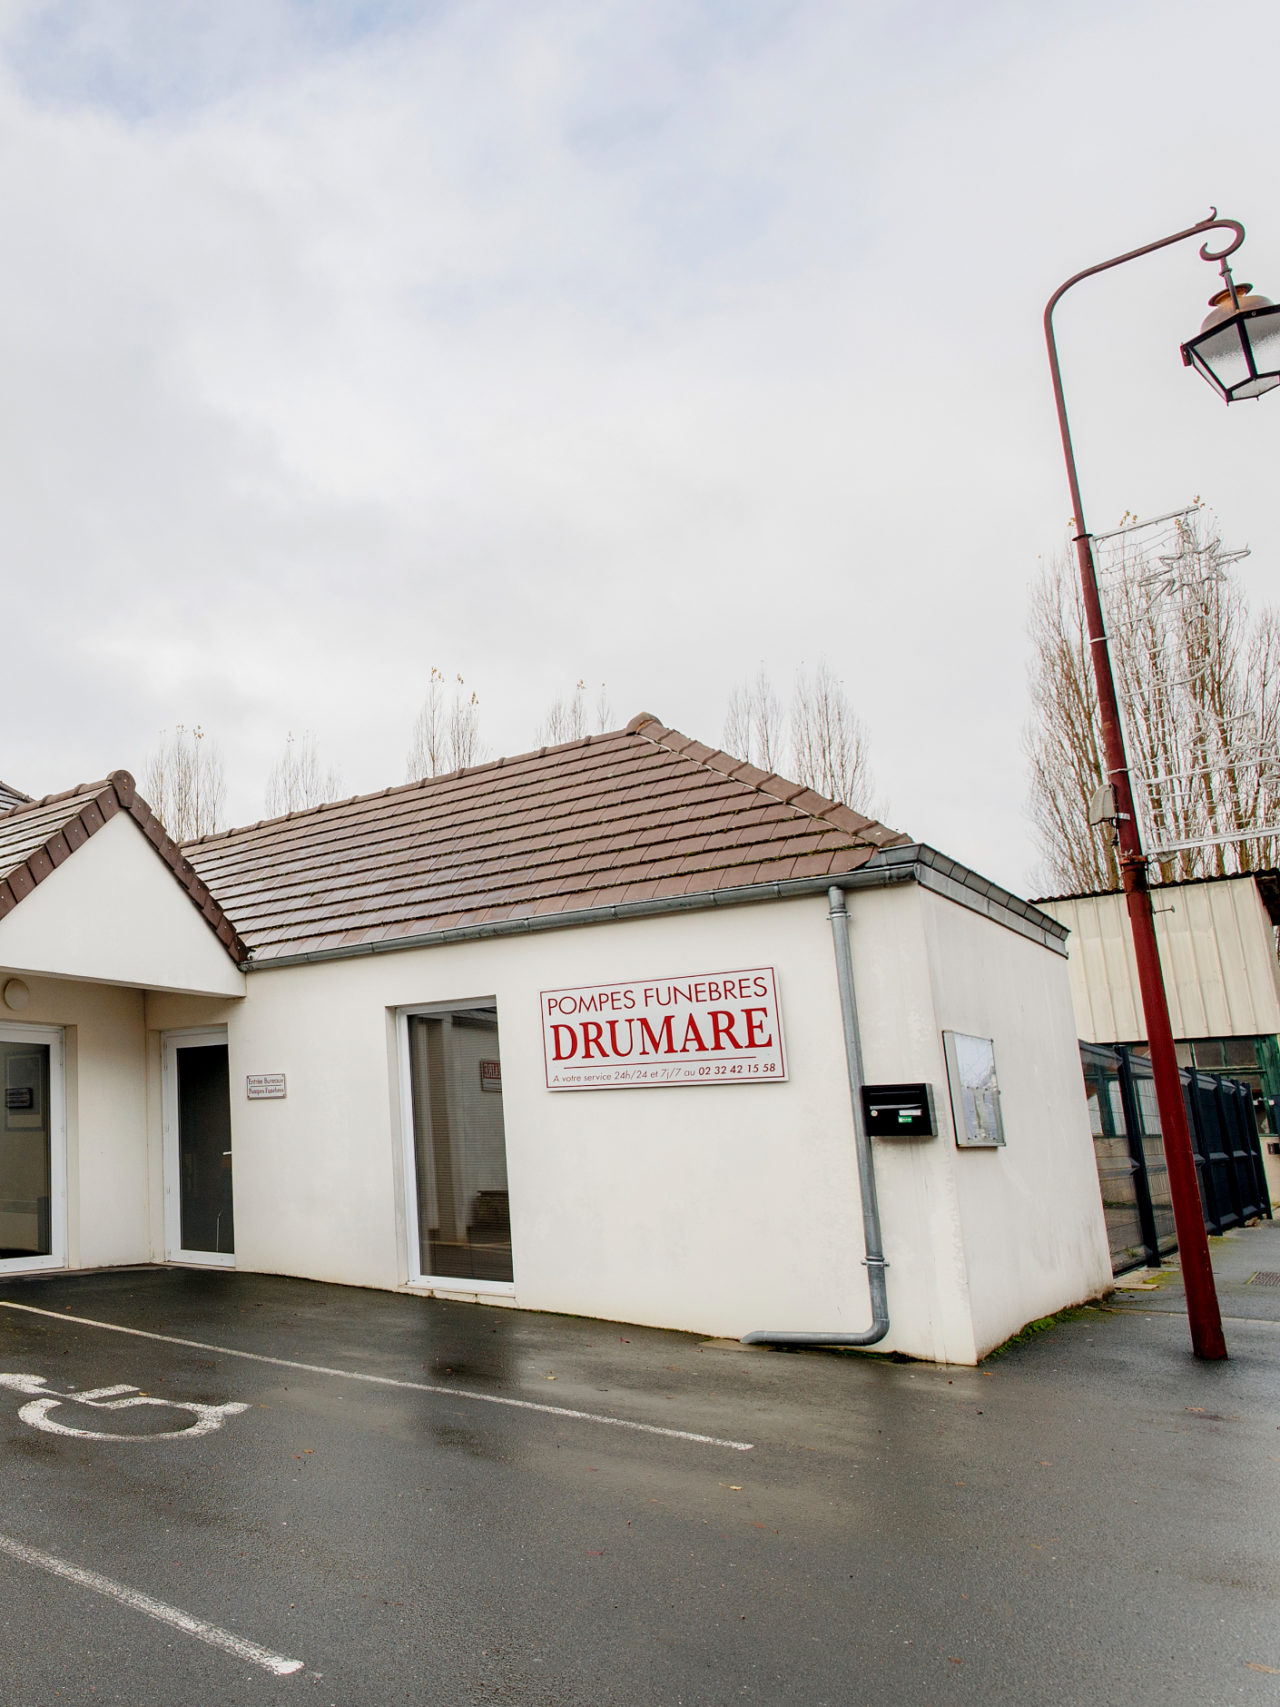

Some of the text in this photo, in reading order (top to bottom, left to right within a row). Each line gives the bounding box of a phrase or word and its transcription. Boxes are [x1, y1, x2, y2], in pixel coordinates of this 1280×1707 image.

[547, 976, 768, 1016] POMPES FUNEBRES
[550, 1007, 773, 1061] DRUMARE
[552, 1075, 560, 1083] A
[562, 1074, 581, 1083] votre
[584, 1072, 612, 1081] service
[614, 1069, 648, 1081] 24h/24
[650, 1071, 658, 1079] et
[660, 1067, 681, 1080] 7j/7
[698, 1066, 711, 1076] 02
[714, 1065, 727, 1075] 32
[729, 1064, 743, 1074] 42
[747, 1063, 759, 1073] 15
[762, 1062, 776, 1072] 58
